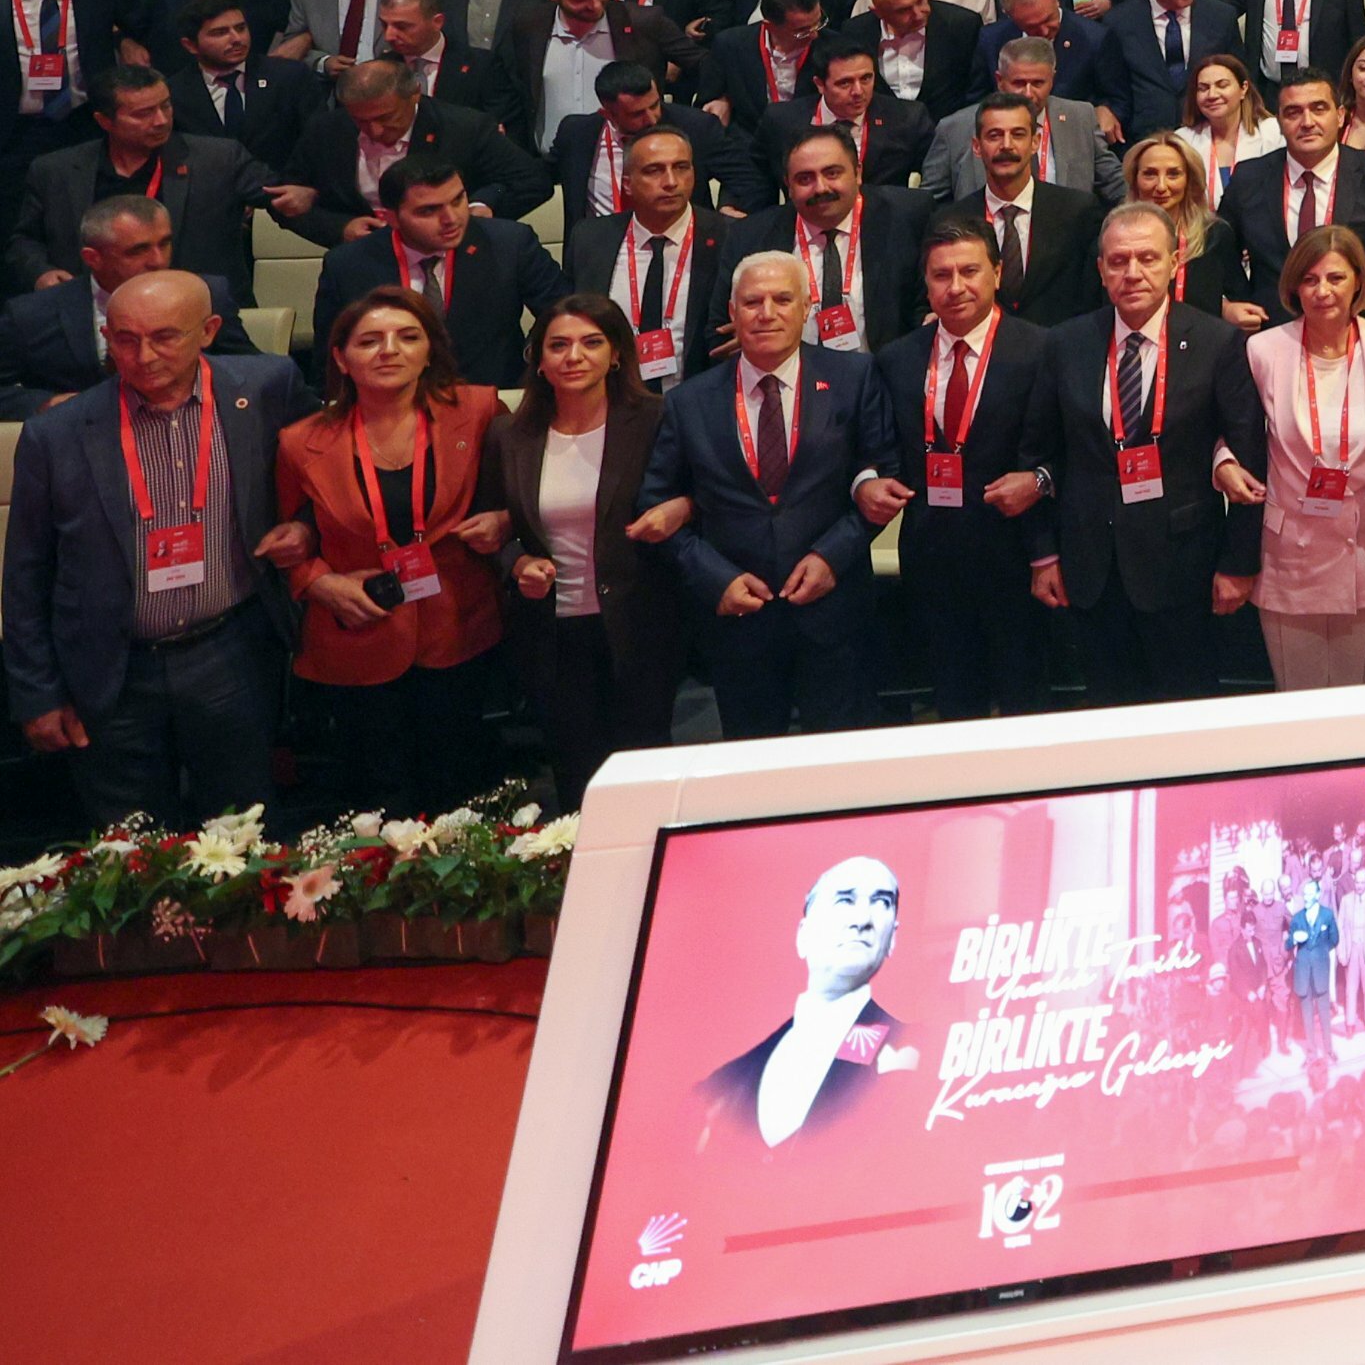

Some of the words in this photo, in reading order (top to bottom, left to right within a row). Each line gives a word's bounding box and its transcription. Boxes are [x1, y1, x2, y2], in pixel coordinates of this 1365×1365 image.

[949, 907, 1119, 984] BİRLİKTE
[938, 1000, 1113, 1081] BİRLİKTE
[629, 1259, 683, 1289] CHP
